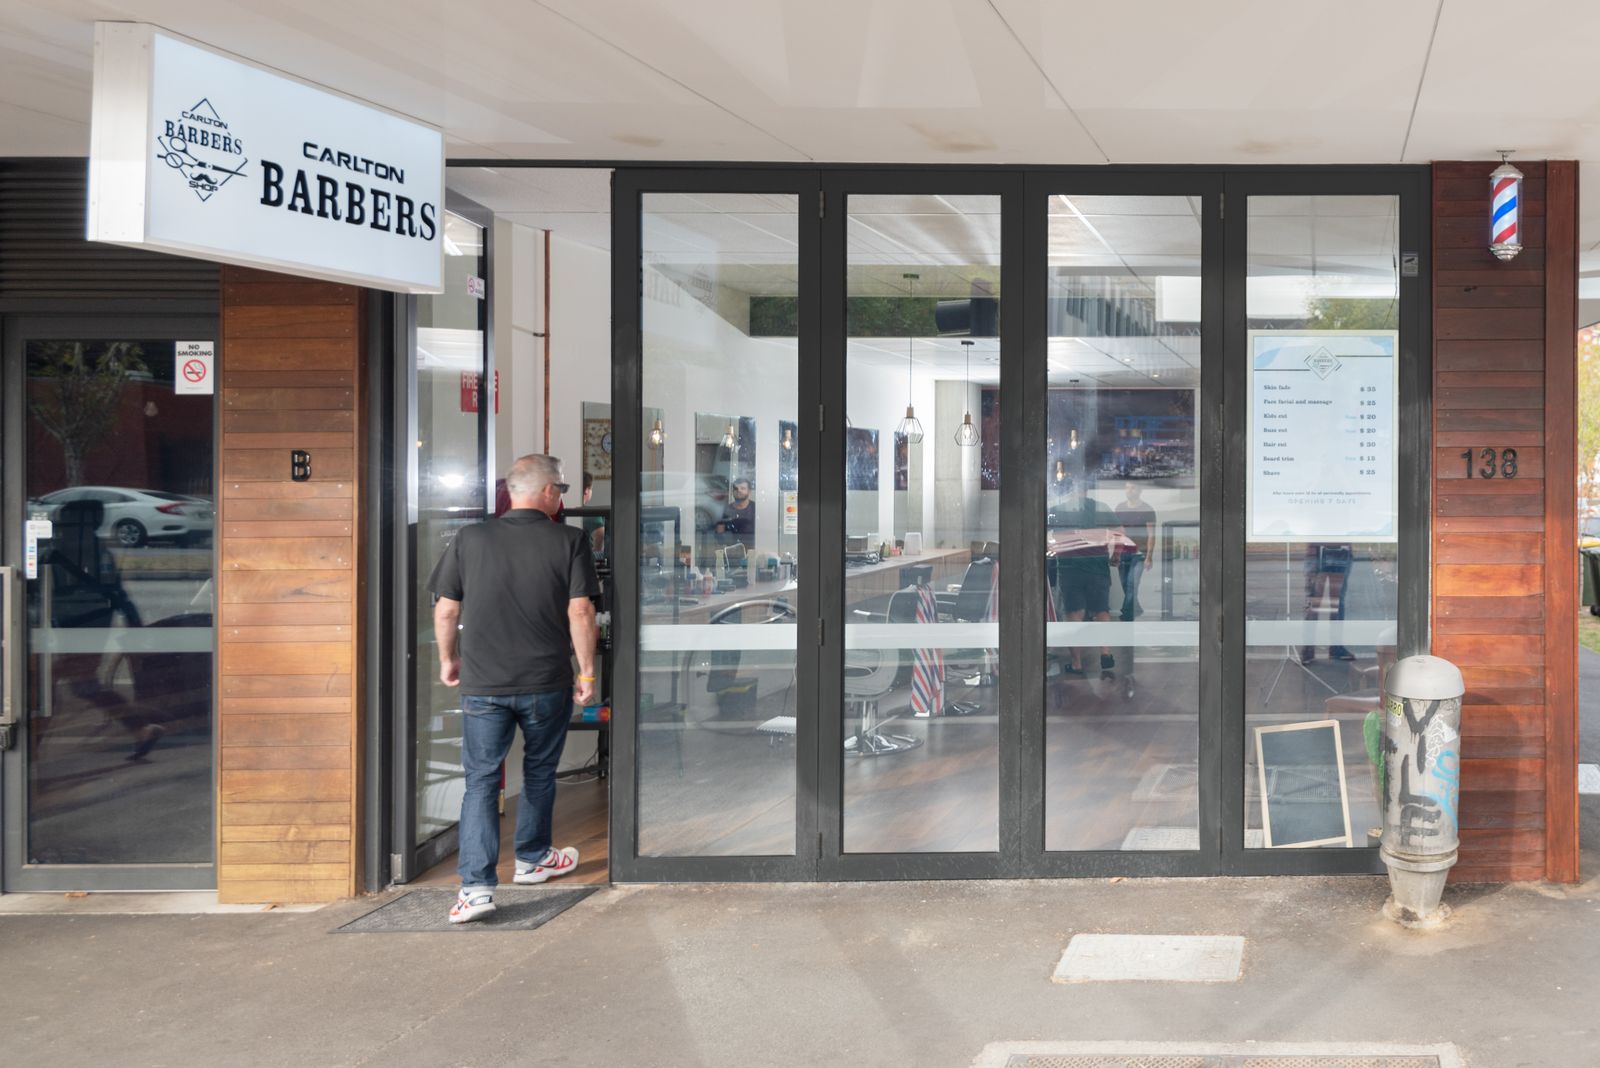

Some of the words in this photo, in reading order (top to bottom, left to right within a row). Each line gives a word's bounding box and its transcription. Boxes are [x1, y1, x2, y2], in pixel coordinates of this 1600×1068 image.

[181, 110, 228, 130] CARLTON
[164, 119, 243, 156] BARBERS
[302, 141, 405, 185] CARLTON
[188, 180, 219, 193] SHOP
[260, 159, 437, 242] BARBERS
[462, 374, 478, 390] FIRE
[291, 449, 312, 482] B
[1461, 447, 1518, 479] 138
